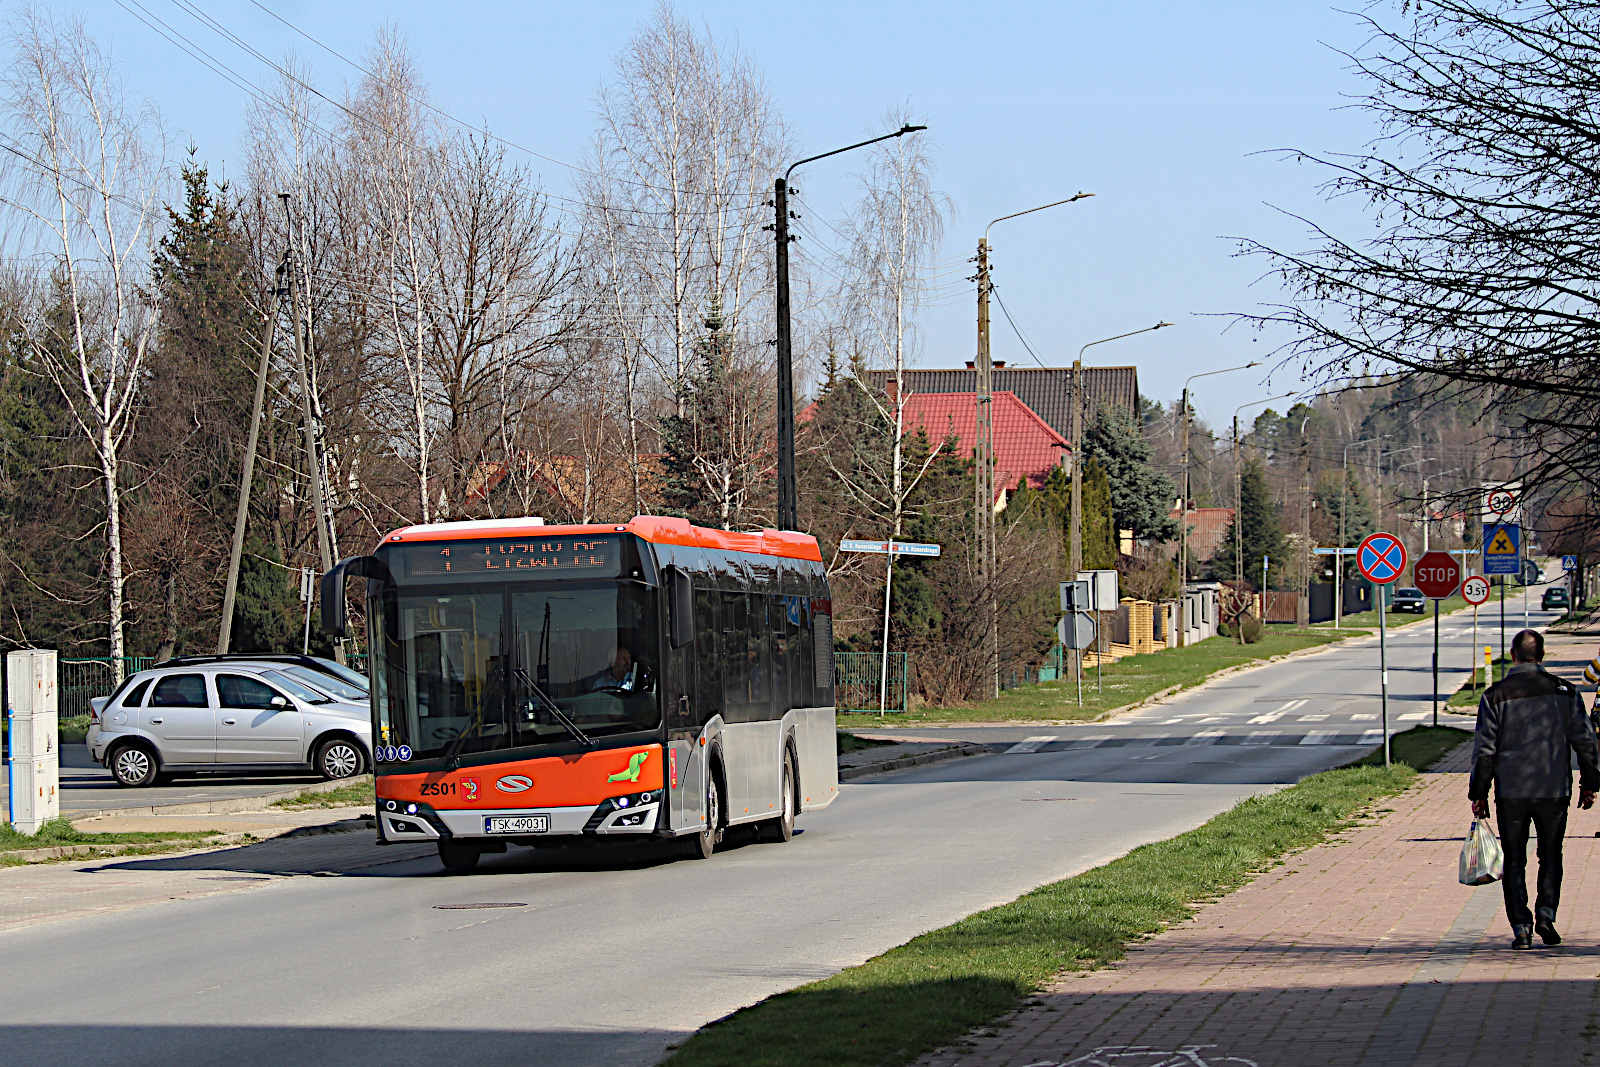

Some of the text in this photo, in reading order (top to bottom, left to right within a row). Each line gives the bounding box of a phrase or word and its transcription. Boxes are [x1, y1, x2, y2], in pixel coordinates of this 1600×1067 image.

[1493, 496, 1511, 508] 30
[855, 543, 882, 551] Konarskiego
[911, 546, 938, 554] Konarskiego
[440, 546, 451, 571] 1
[1418, 568, 1456, 582] STOP
[420, 782, 456, 796] ZS01
[492, 818, 544, 830] TSK 49031
